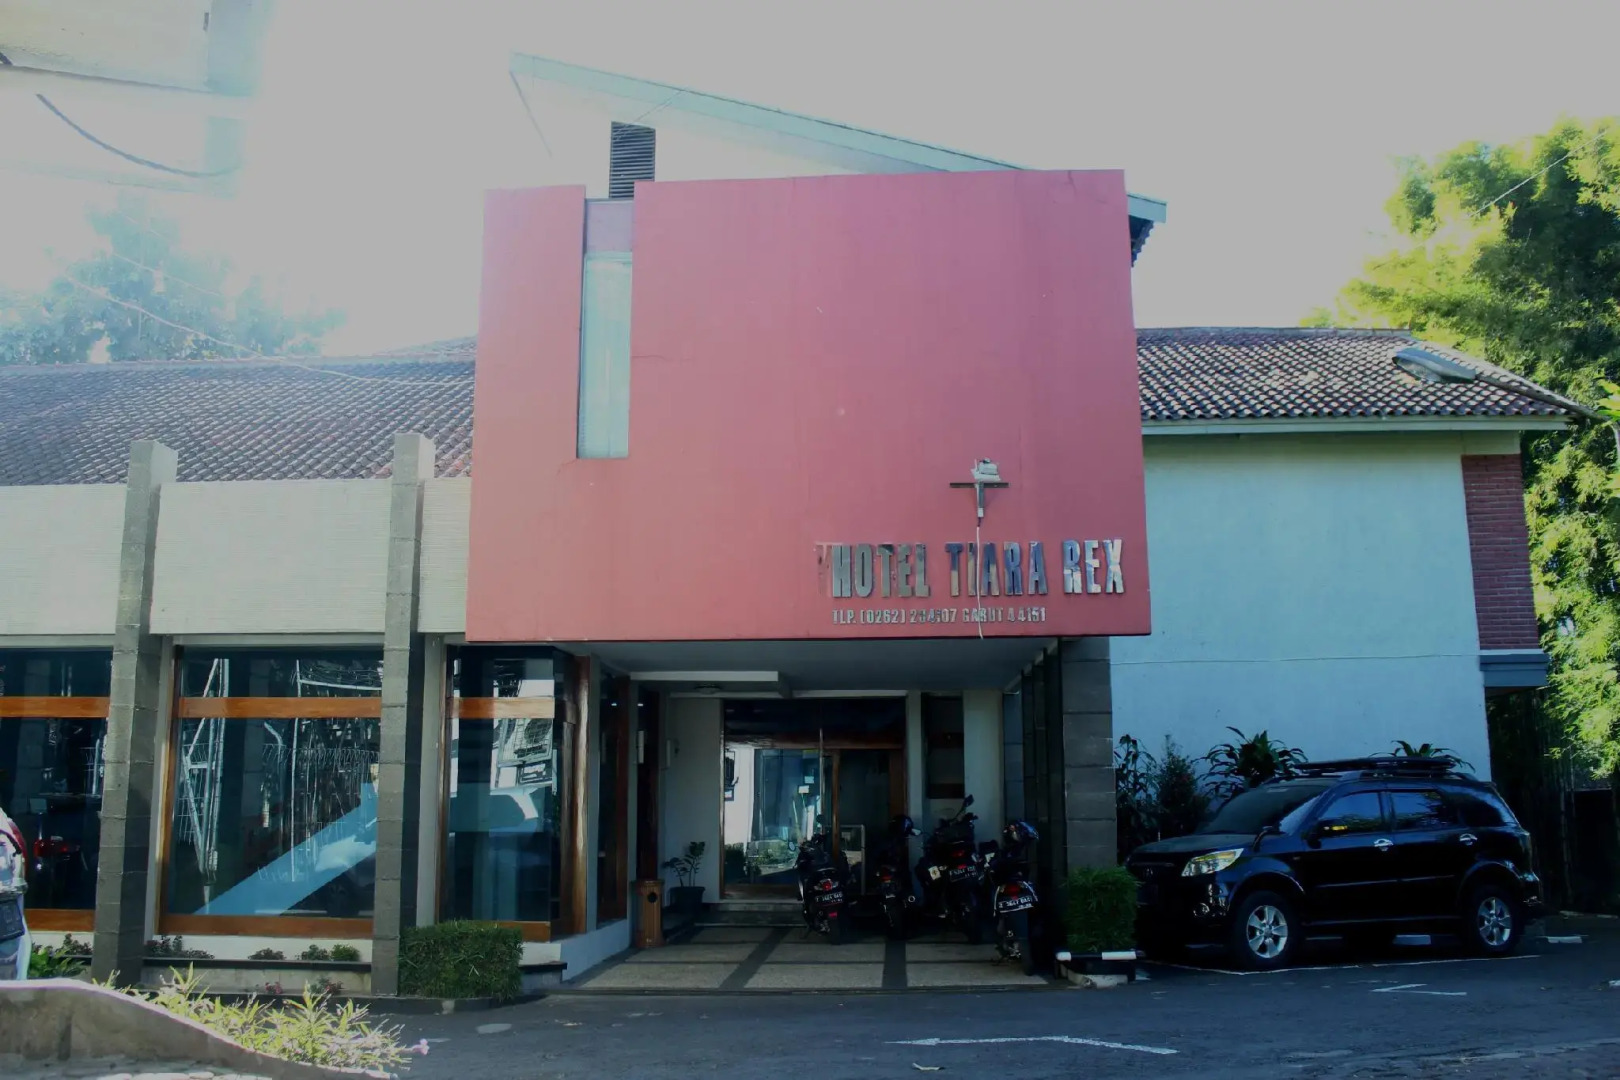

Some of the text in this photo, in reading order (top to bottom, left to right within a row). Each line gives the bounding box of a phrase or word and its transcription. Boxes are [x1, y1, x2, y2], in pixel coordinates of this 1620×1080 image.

[832, 538, 1125, 598] HOTEL TIARA REX
[832, 609, 857, 625] TLP.
[962, 607, 1003, 624] GARUT
